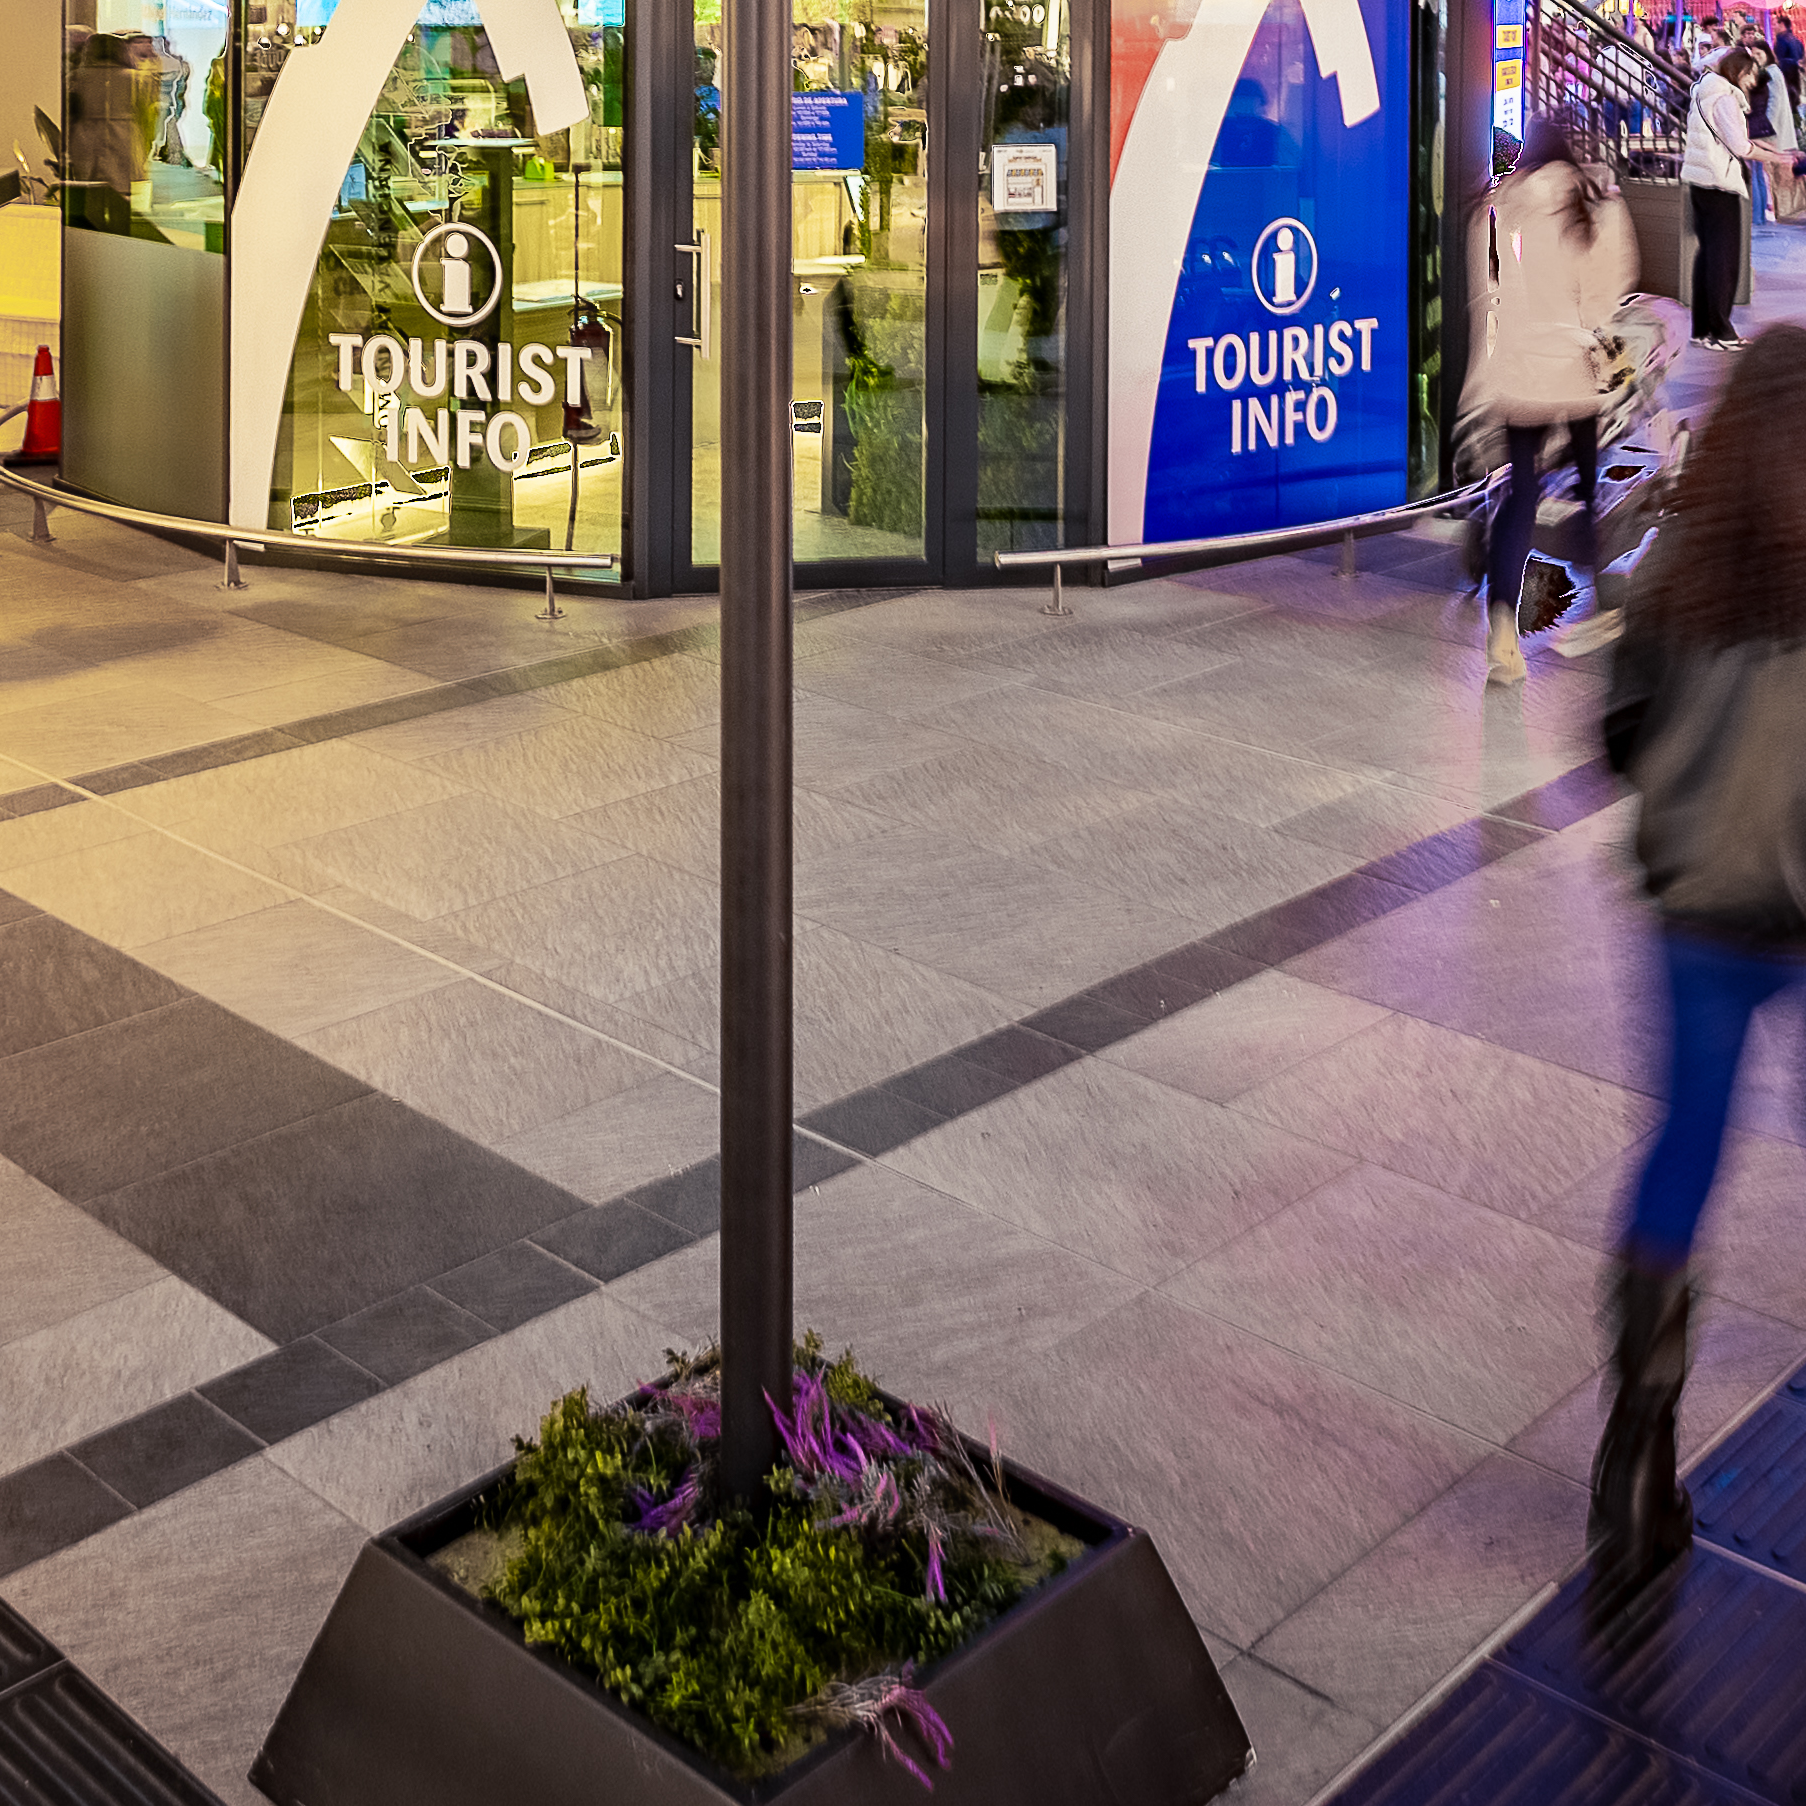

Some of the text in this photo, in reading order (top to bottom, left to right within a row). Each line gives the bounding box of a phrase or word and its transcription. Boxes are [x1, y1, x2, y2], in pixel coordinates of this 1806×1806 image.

[329, 333, 592, 407] TOURIST
[1187, 317, 1379, 394] TOURIST
[384, 406, 531, 472] INFO
[1230, 385, 1338, 456] INFO
